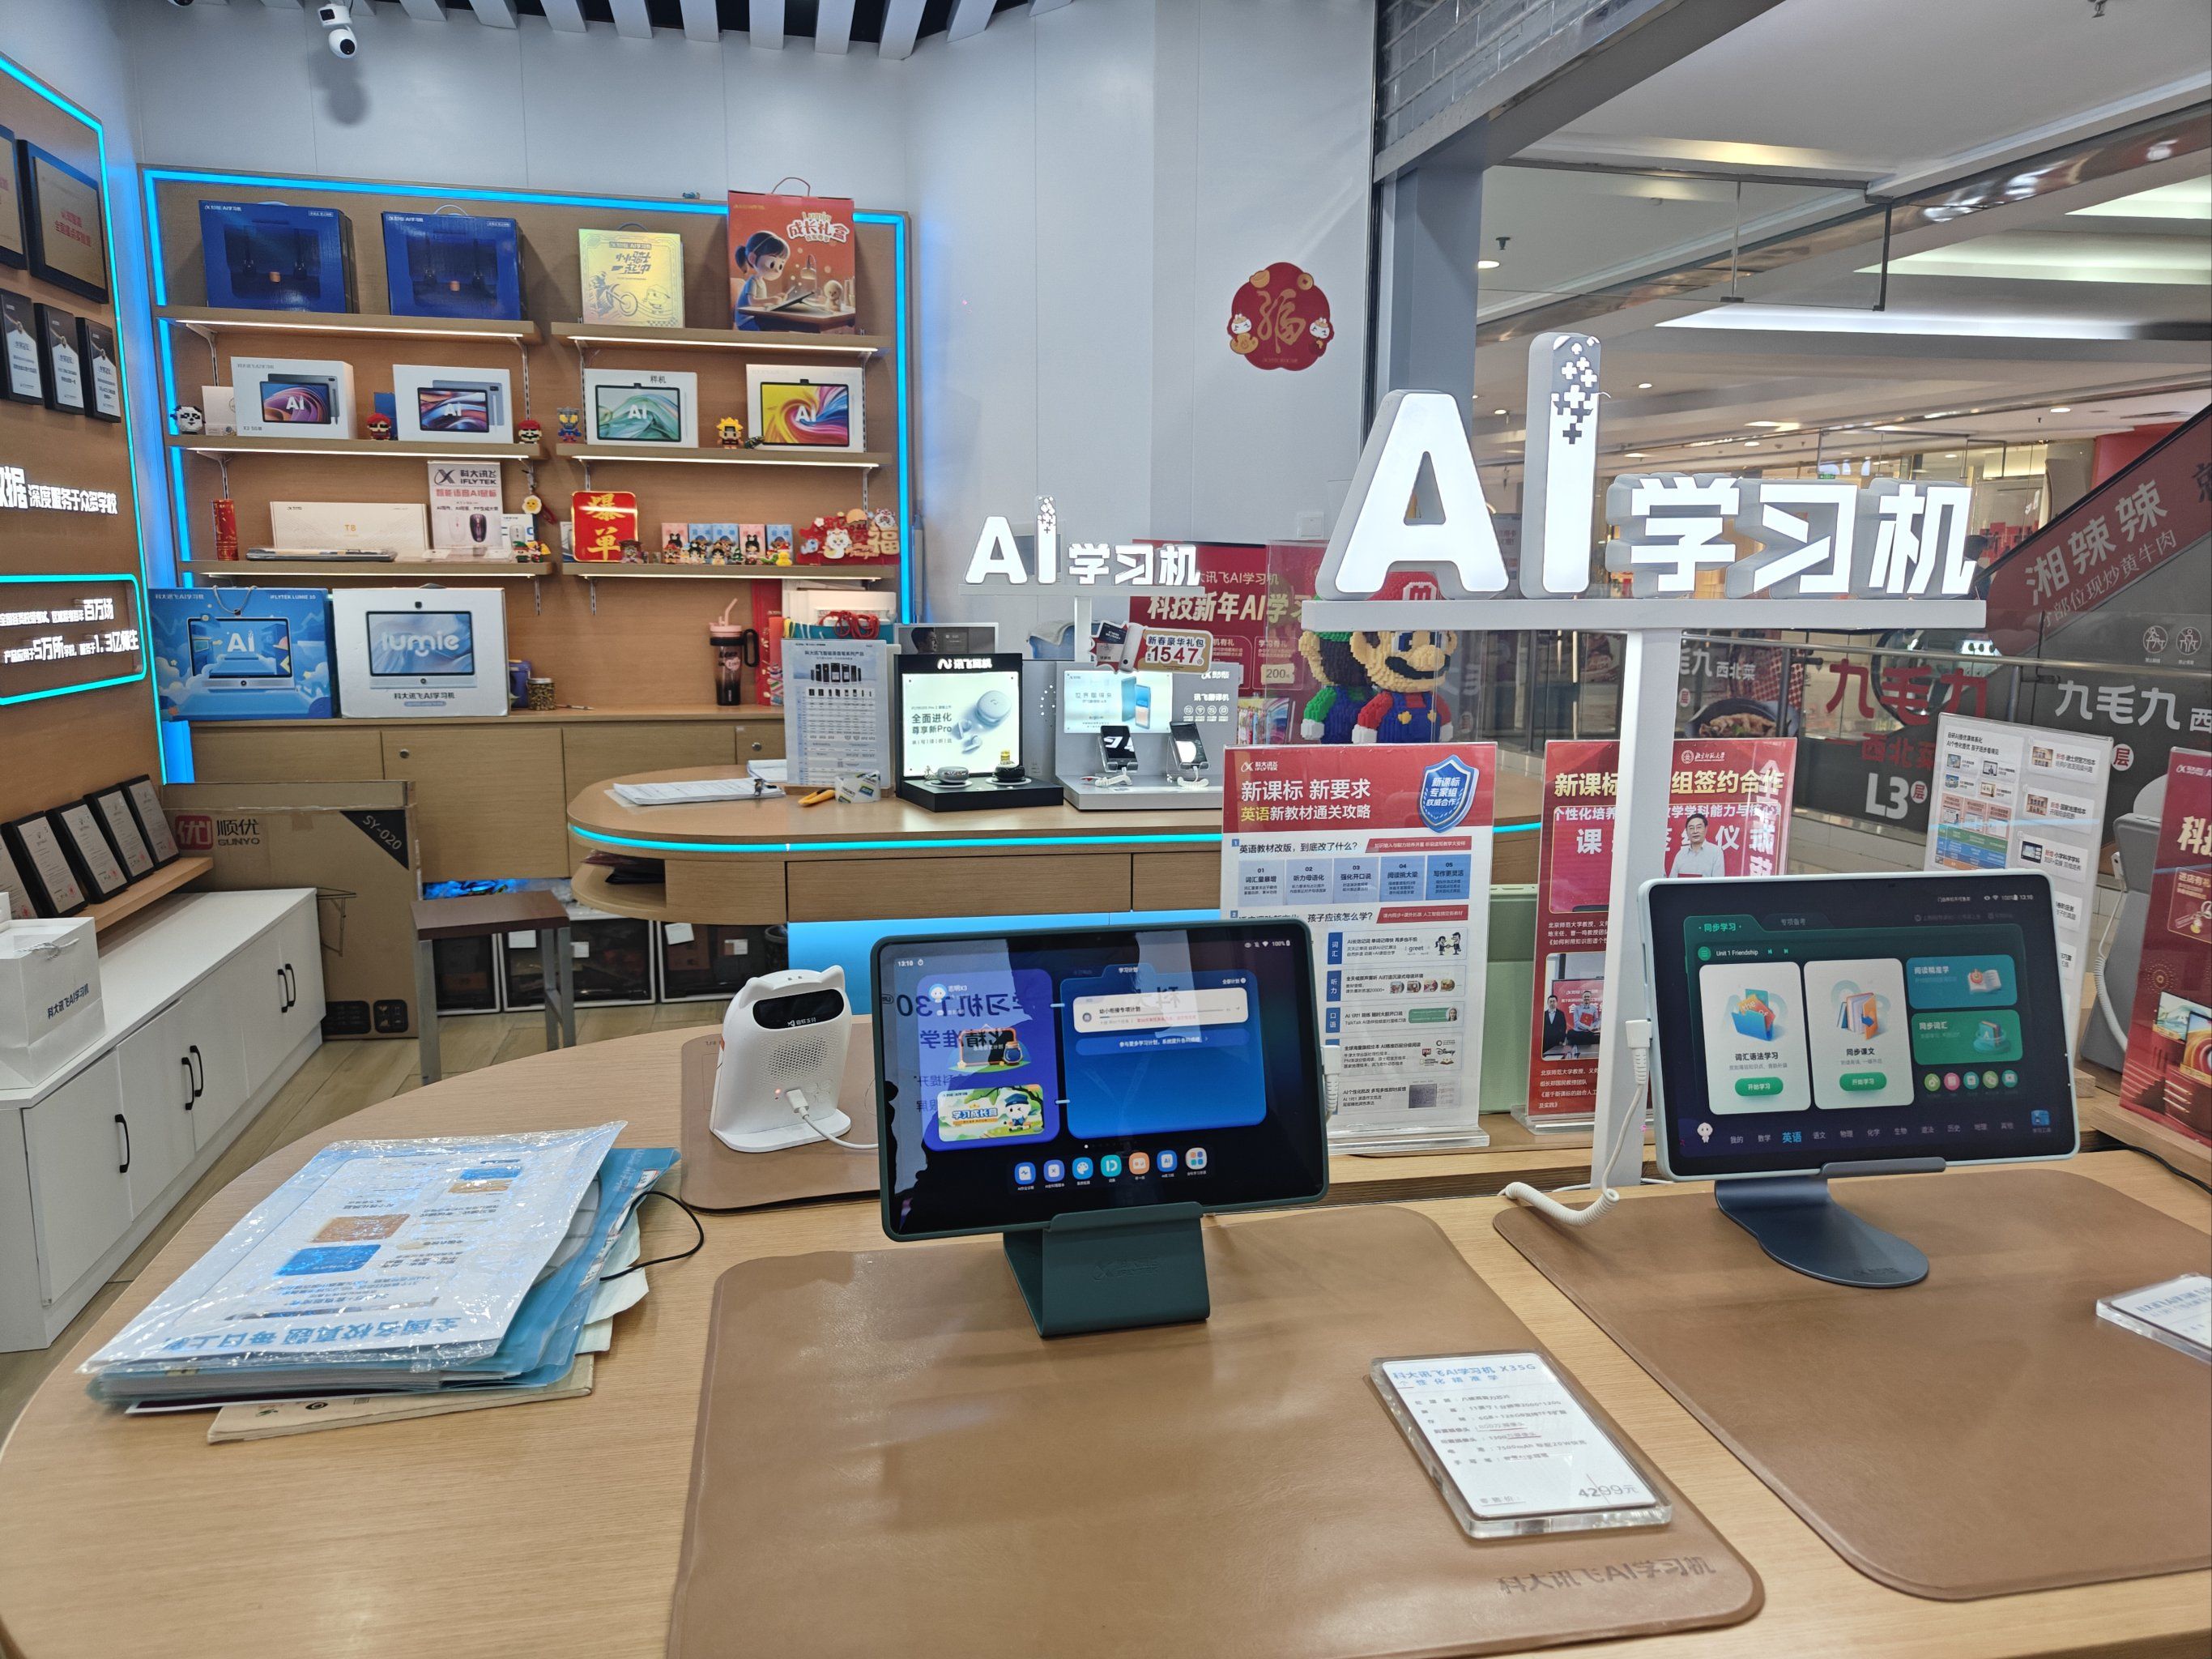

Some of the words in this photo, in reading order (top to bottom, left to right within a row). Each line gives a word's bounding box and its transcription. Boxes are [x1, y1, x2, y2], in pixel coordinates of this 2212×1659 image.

[786, 220, 850, 242] 成长礼盒
[650, 375, 667, 384] 样机
[286, 394, 305, 411] AI
[444, 403, 462, 418] AI
[628, 405, 647, 420] AI
[795, 405, 816, 422] AI
[1335, 335, 1976, 595] AI学习机
[460, 470, 497, 478] 科大讯飞
[587, 493, 627, 561] 爆单
[965, 495, 1201, 586] AI学习机
[2026, 480, 2168, 606] 湘辣辣
[227, 629, 256, 654] AI
[382, 630, 460, 658] lumie
[1148, 635, 1204, 647] 新春豪华礼包
[1150, 647, 1200, 663] 1547
[1716, 661, 1756, 681] 西北菜
[394, 692, 455, 700] 科大讯飞AI学习机
[2055, 680, 2181, 731] 九毛九
[911, 712, 953, 724] 全面进化
[911, 723, 953, 736] 尊享新Pro
[1432, 776, 1460, 787] 新课标
[1241, 781, 1303, 802] 新课标
[1310, 778, 1370, 800] 新要求
[1430, 787, 1458, 797] 专家组
[1241, 804, 1371, 821] 英语新教材通关攻略
[216, 817, 261, 837] 顺优
[361, 812, 403, 851] SY-020
[1239, 841, 1357, 854] 英语教材改版，到底改了什么？
[1340, 872, 1371, 881] 强化开口说
[1433, 869, 1464, 877] 写作更灵活
[1306, 912, 1374, 923] 孩子应该怎么学？
[1703, 922, 1737, 932] 同步学习
[1732, 949, 1758, 957] Friendship
[47, 983, 90, 1020] 科大讯飞AI学习机
[1735, 1051, 1779, 1061] 词汇语法学习
[1846, 1047, 1876, 1056] 同步课文
[1747, 1082, 1771, 1091] 开始学习
[1852, 1077, 1875, 1086] 开始学习
[1730, 1136, 1744, 1145] 我的
[1758, 1134, 1771, 1143] 数学
[1782, 1131, 1802, 1144] 英语
[1813, 1132, 1826, 1140] 语文
[1839, 1130, 1853, 1139] 物理
[1867, 1128, 1881, 1137] 化学
[1947, 1124, 1961, 1133] 历史
[282, 1316, 462, 1346] 全国名校真题
[1392, 1366, 1496, 1380] 科大讯飞AI学习机
[1577, 1483, 1639, 1500] 4299元
[1495, 1555, 1718, 1595] 科大讯飞AI学习机
